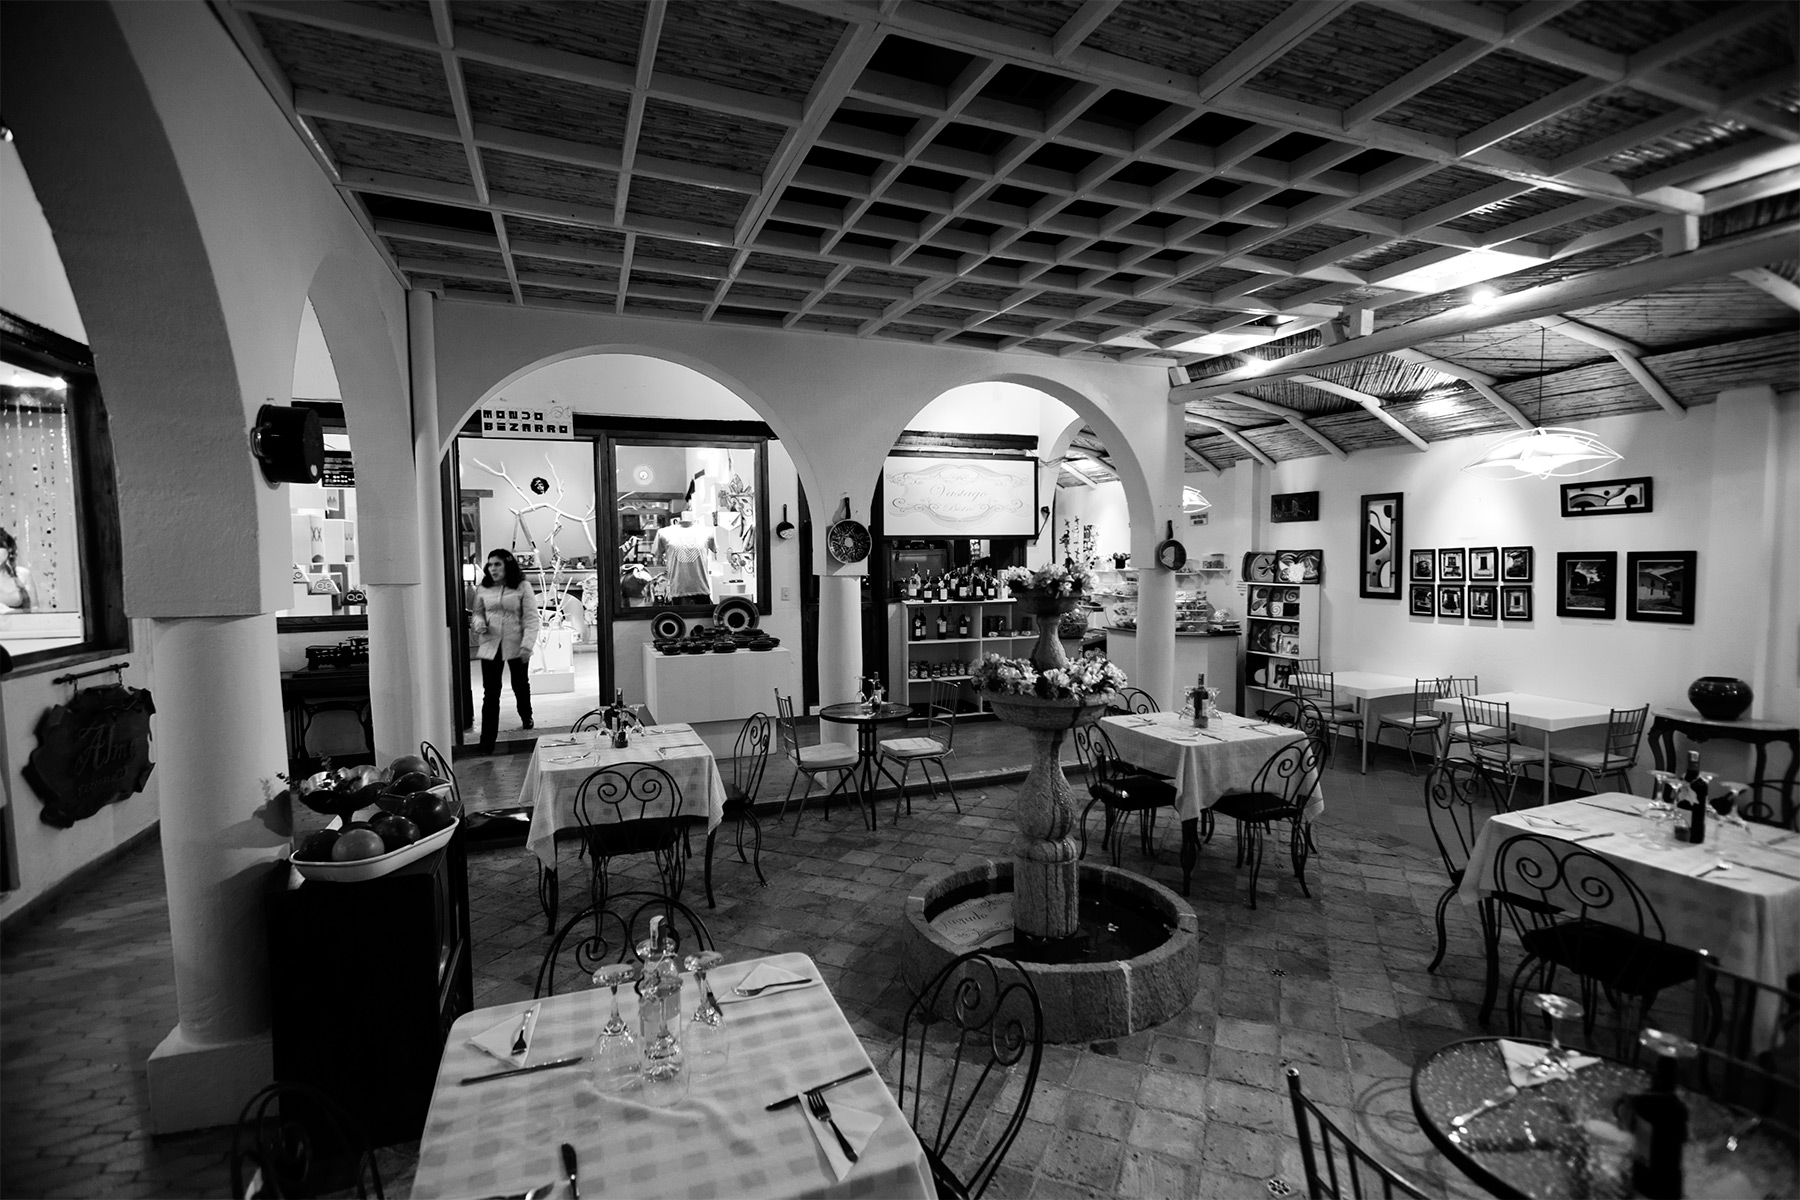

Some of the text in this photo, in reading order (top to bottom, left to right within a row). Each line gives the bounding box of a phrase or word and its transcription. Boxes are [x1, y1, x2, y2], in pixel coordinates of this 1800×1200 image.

[483, 410, 543, 421] MONDO
[483, 422, 568, 434] BIZARRO
[929, 484, 987, 503] Vastago
